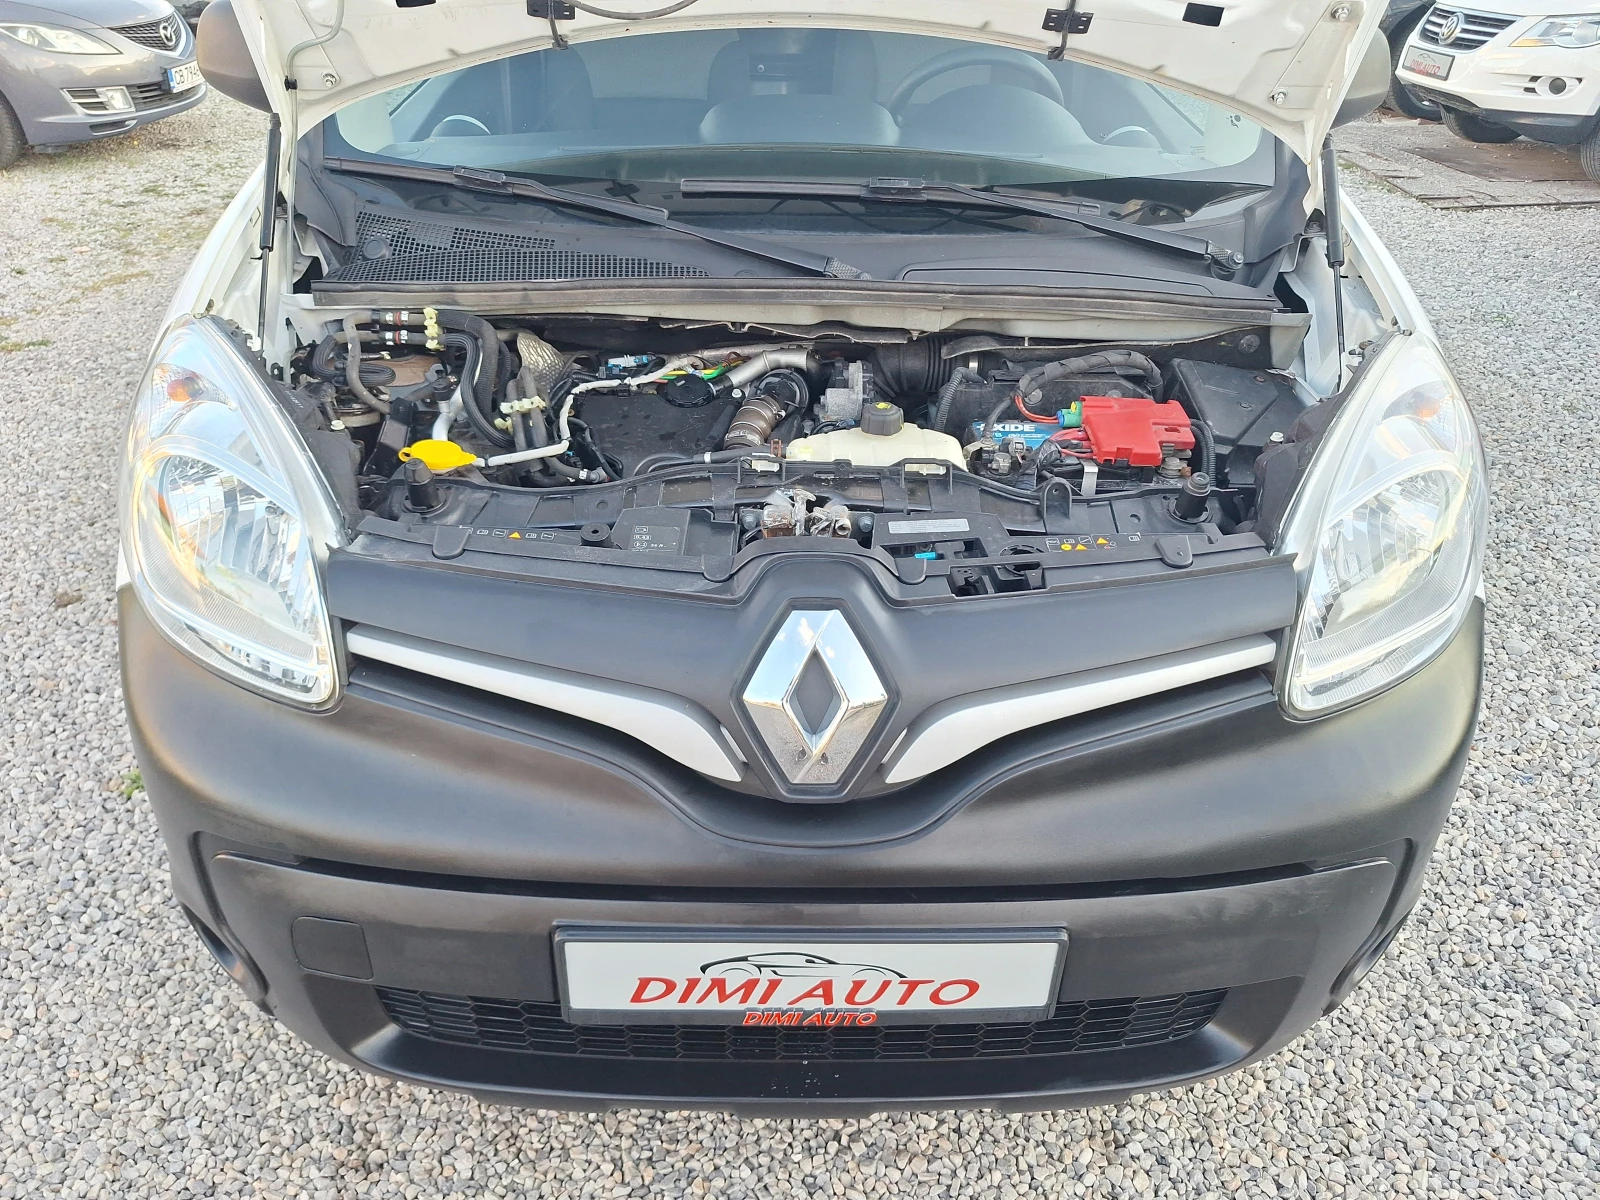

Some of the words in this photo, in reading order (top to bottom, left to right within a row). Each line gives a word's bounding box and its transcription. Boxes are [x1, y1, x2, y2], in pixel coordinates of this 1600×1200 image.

[629, 976, 784, 1005] DIMI
[785, 978, 981, 1007] AUTO
[742, 1010, 804, 1026] DIMI
[802, 1011, 878, 1027] AUTO
